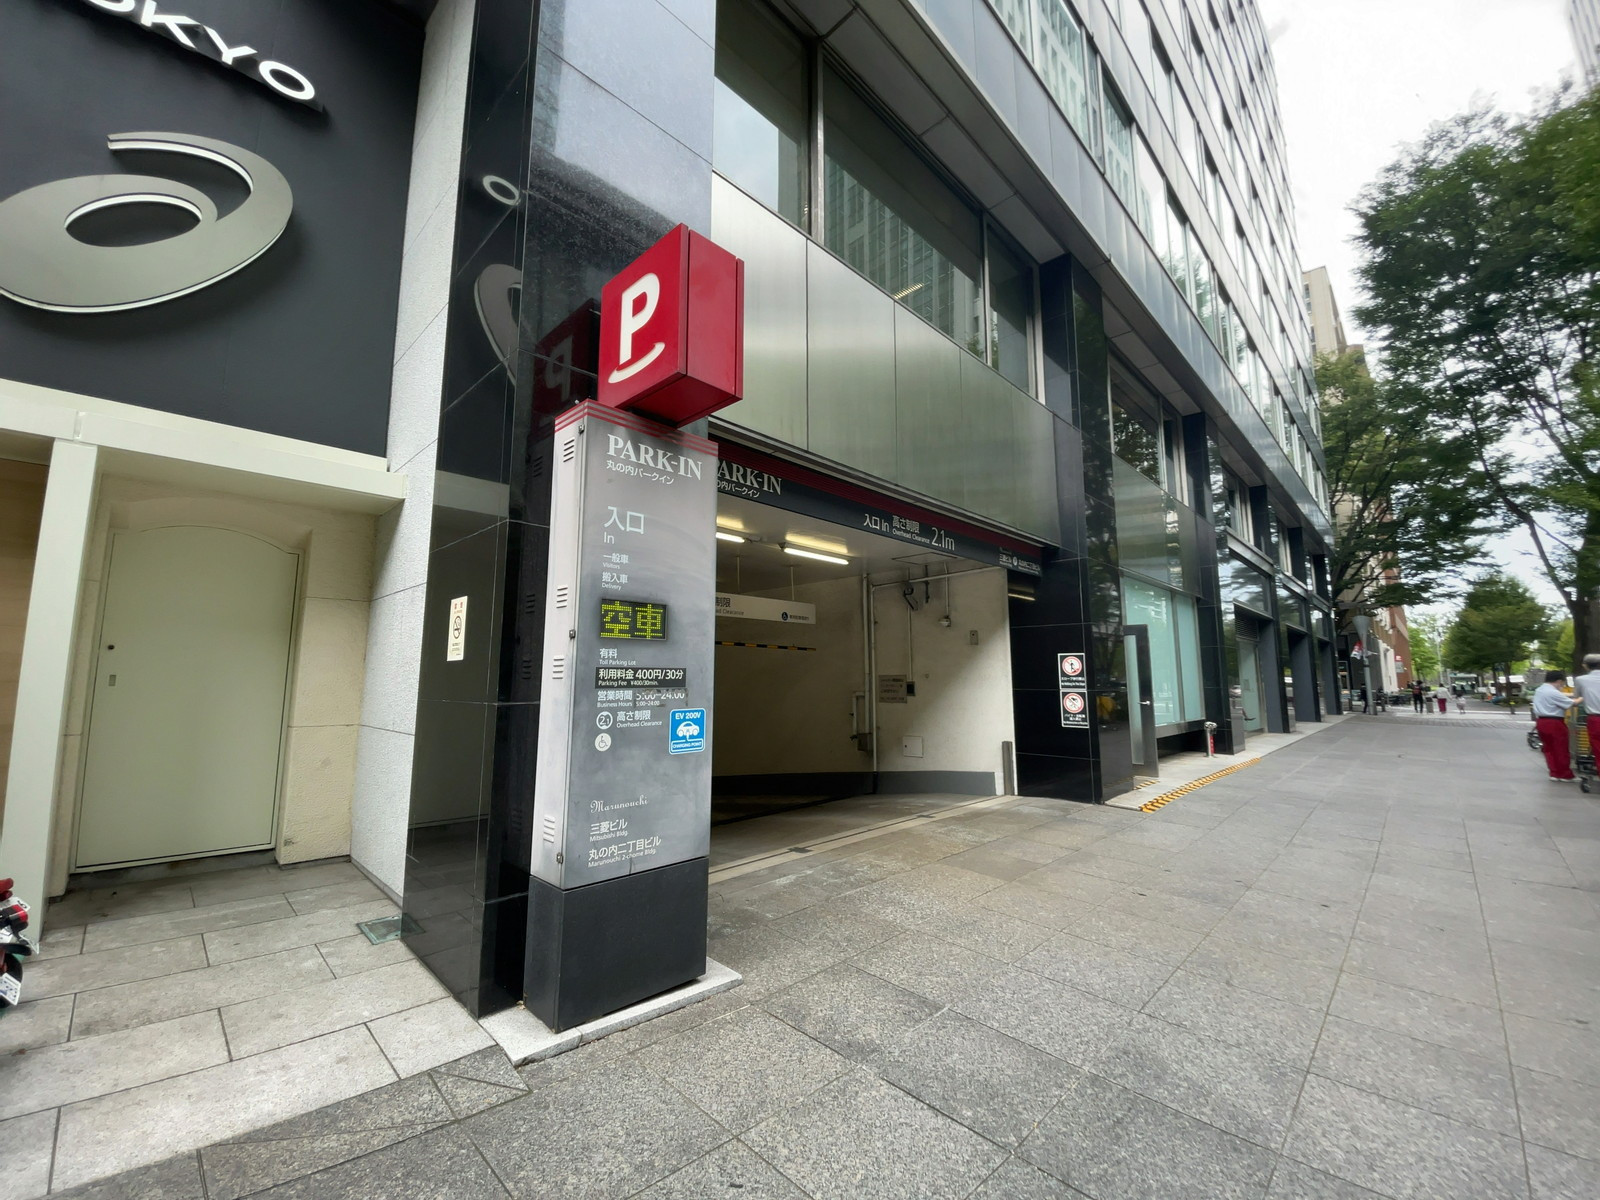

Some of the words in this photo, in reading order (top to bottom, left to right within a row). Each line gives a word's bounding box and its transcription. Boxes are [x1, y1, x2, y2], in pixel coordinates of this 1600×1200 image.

[86, 0, 316, 101] KYO
[619, 272, 660, 366] P
[606, 433, 702, 480] PARK-IN
[606, 459, 675, 485] 丸の内パークイン
[717, 459, 782, 495] ARK-IN
[604, 506, 644, 535] 入口
[863, 513, 880, 530] 入口
[881, 519, 890, 533] In
[892, 514, 920, 534] 高さ制限
[603, 531, 615, 544] In
[931, 527, 955, 551] 2.1m
[603, 552, 629, 564] 一般車
[602, 571, 628, 584] 搬入車
[601, 583, 622, 591] Delivery
[600, 600, 664, 640] 空車
[600, 648, 618, 659] 有料
[598, 668, 635, 680] 利用料金
[635, 669, 684, 680] 400円/30分
[598, 680, 618, 688] Parking
[597, 690, 633, 701] 営業時間
[617, 709, 651, 722] 高さ制限
[675, 712, 684, 720] EV
[685, 711, 702, 720] 200V
[590, 795, 648, 813] Marunouchi
[590, 818, 628, 835] 三菱ビル
[589, 833, 616, 842] Mitsubishi
[588, 835, 662, 861] 丸の内二丁目ビル
[587, 856, 620, 868] Marunouchi
[621, 851, 643, 861] 2-chome
